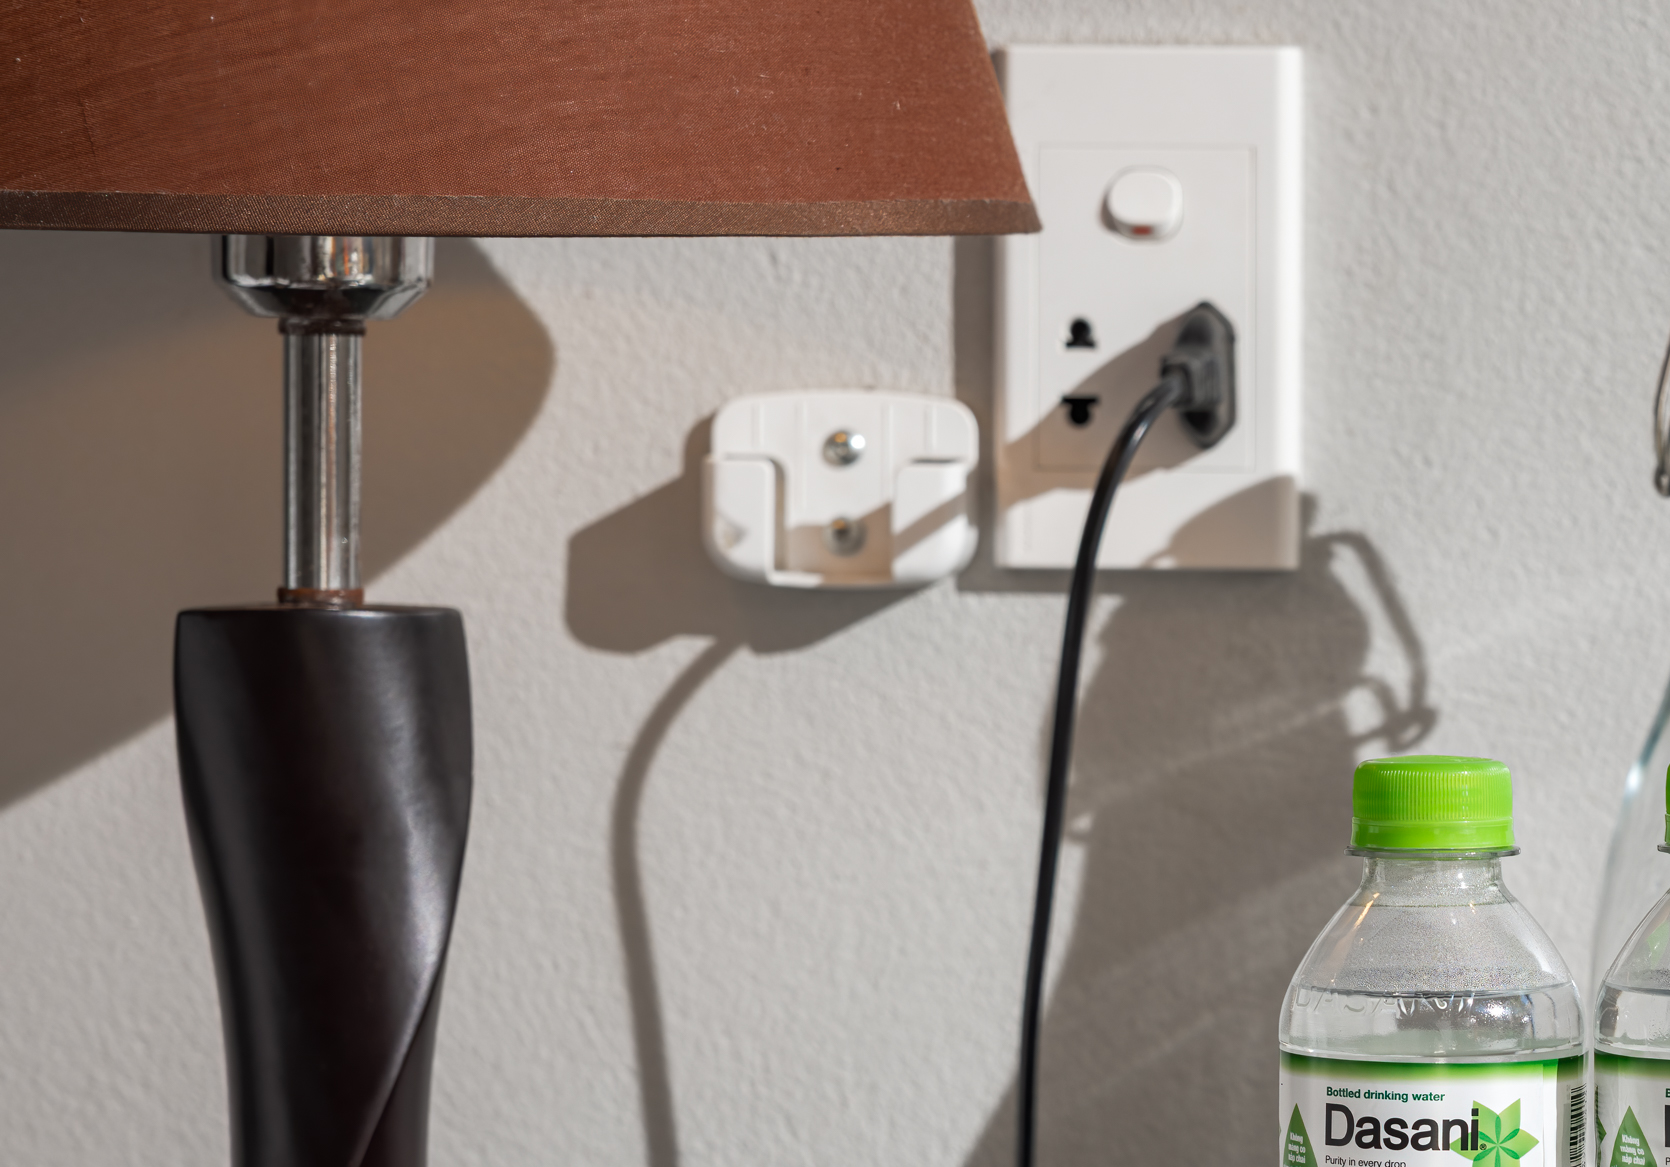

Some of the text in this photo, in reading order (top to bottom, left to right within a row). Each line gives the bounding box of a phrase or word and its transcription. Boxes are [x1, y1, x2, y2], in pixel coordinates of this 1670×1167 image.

[1326, 1086, 1446, 1103] Bottled drinking water
[1325, 1155, 1347, 1167] Purity
[1348, 1156, 1356, 1166] in
